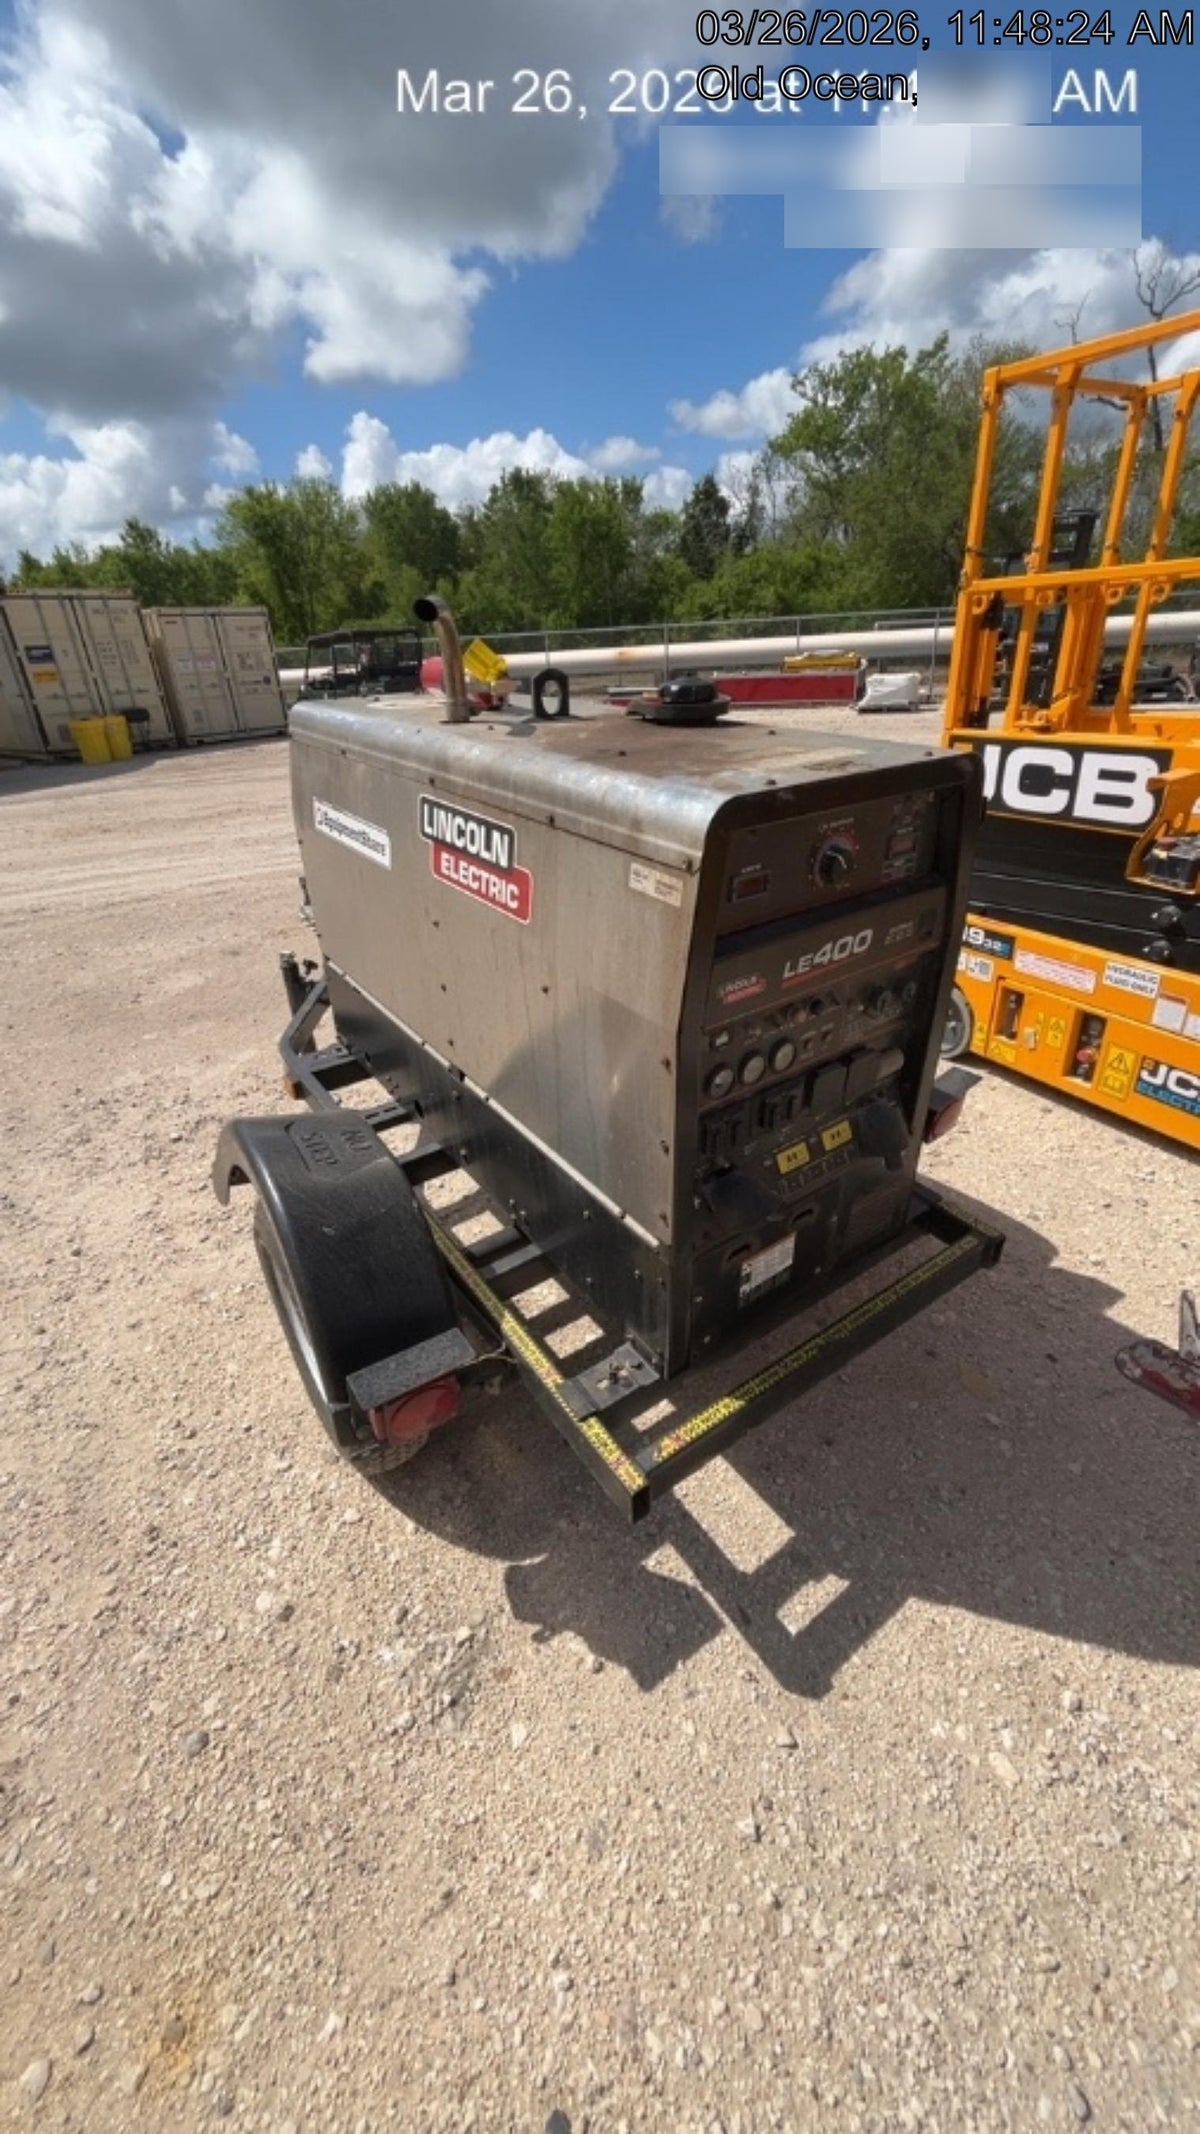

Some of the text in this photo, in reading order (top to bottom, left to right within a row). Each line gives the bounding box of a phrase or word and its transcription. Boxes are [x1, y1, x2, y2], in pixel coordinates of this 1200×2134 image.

[423, 803, 510, 868] LINCOLN
[440, 851, 519, 909] ELECTRIC
[782, 929, 874, 978] LE400
[1107, 964, 1158, 985] HYDRAULIC
[1130, 981, 1156, 994] ONLY
[1140, 1064, 1200, 1103] JC
